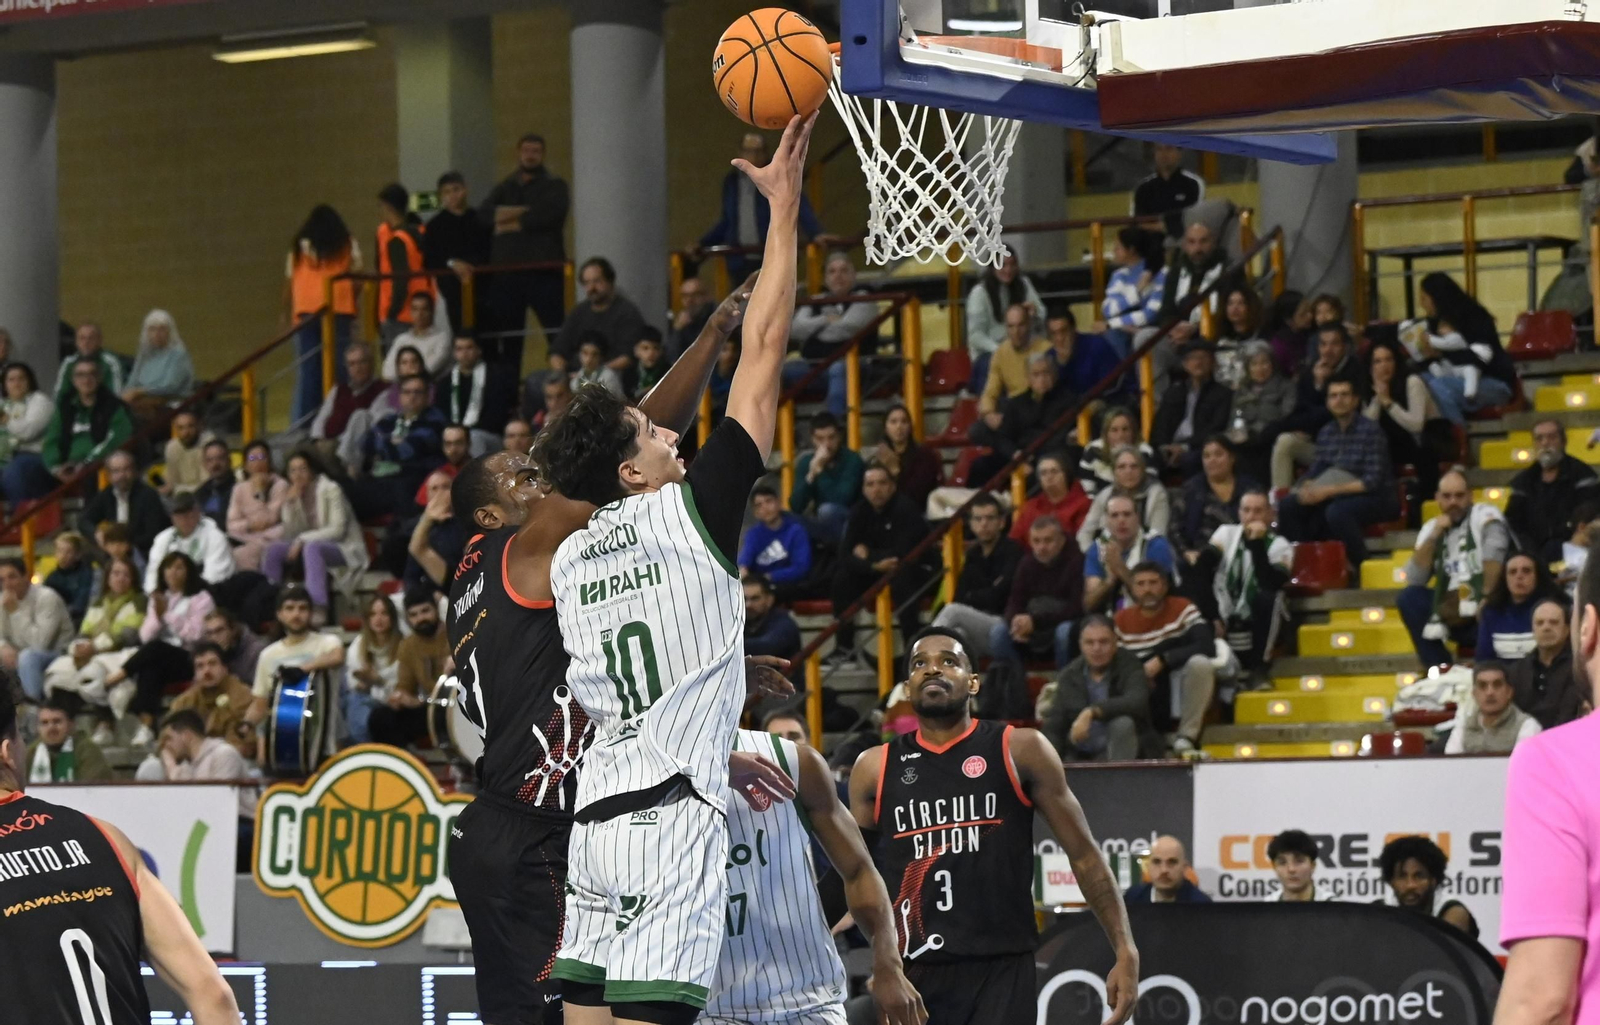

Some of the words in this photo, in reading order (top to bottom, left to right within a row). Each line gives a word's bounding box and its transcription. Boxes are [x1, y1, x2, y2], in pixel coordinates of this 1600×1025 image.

[609, 562, 662, 598] RAHI
[601, 620, 663, 721] 10
[631, 810, 659, 821] PRO
[894, 792, 997, 833] CÍRCULO
[270, 805, 455, 887] CORDOB
[913, 823, 980, 860] GIJÓN
[934, 869, 954, 912] 3
[60, 928, 113, 1025] 0
[1240, 982, 1443, 1025] nogomet
